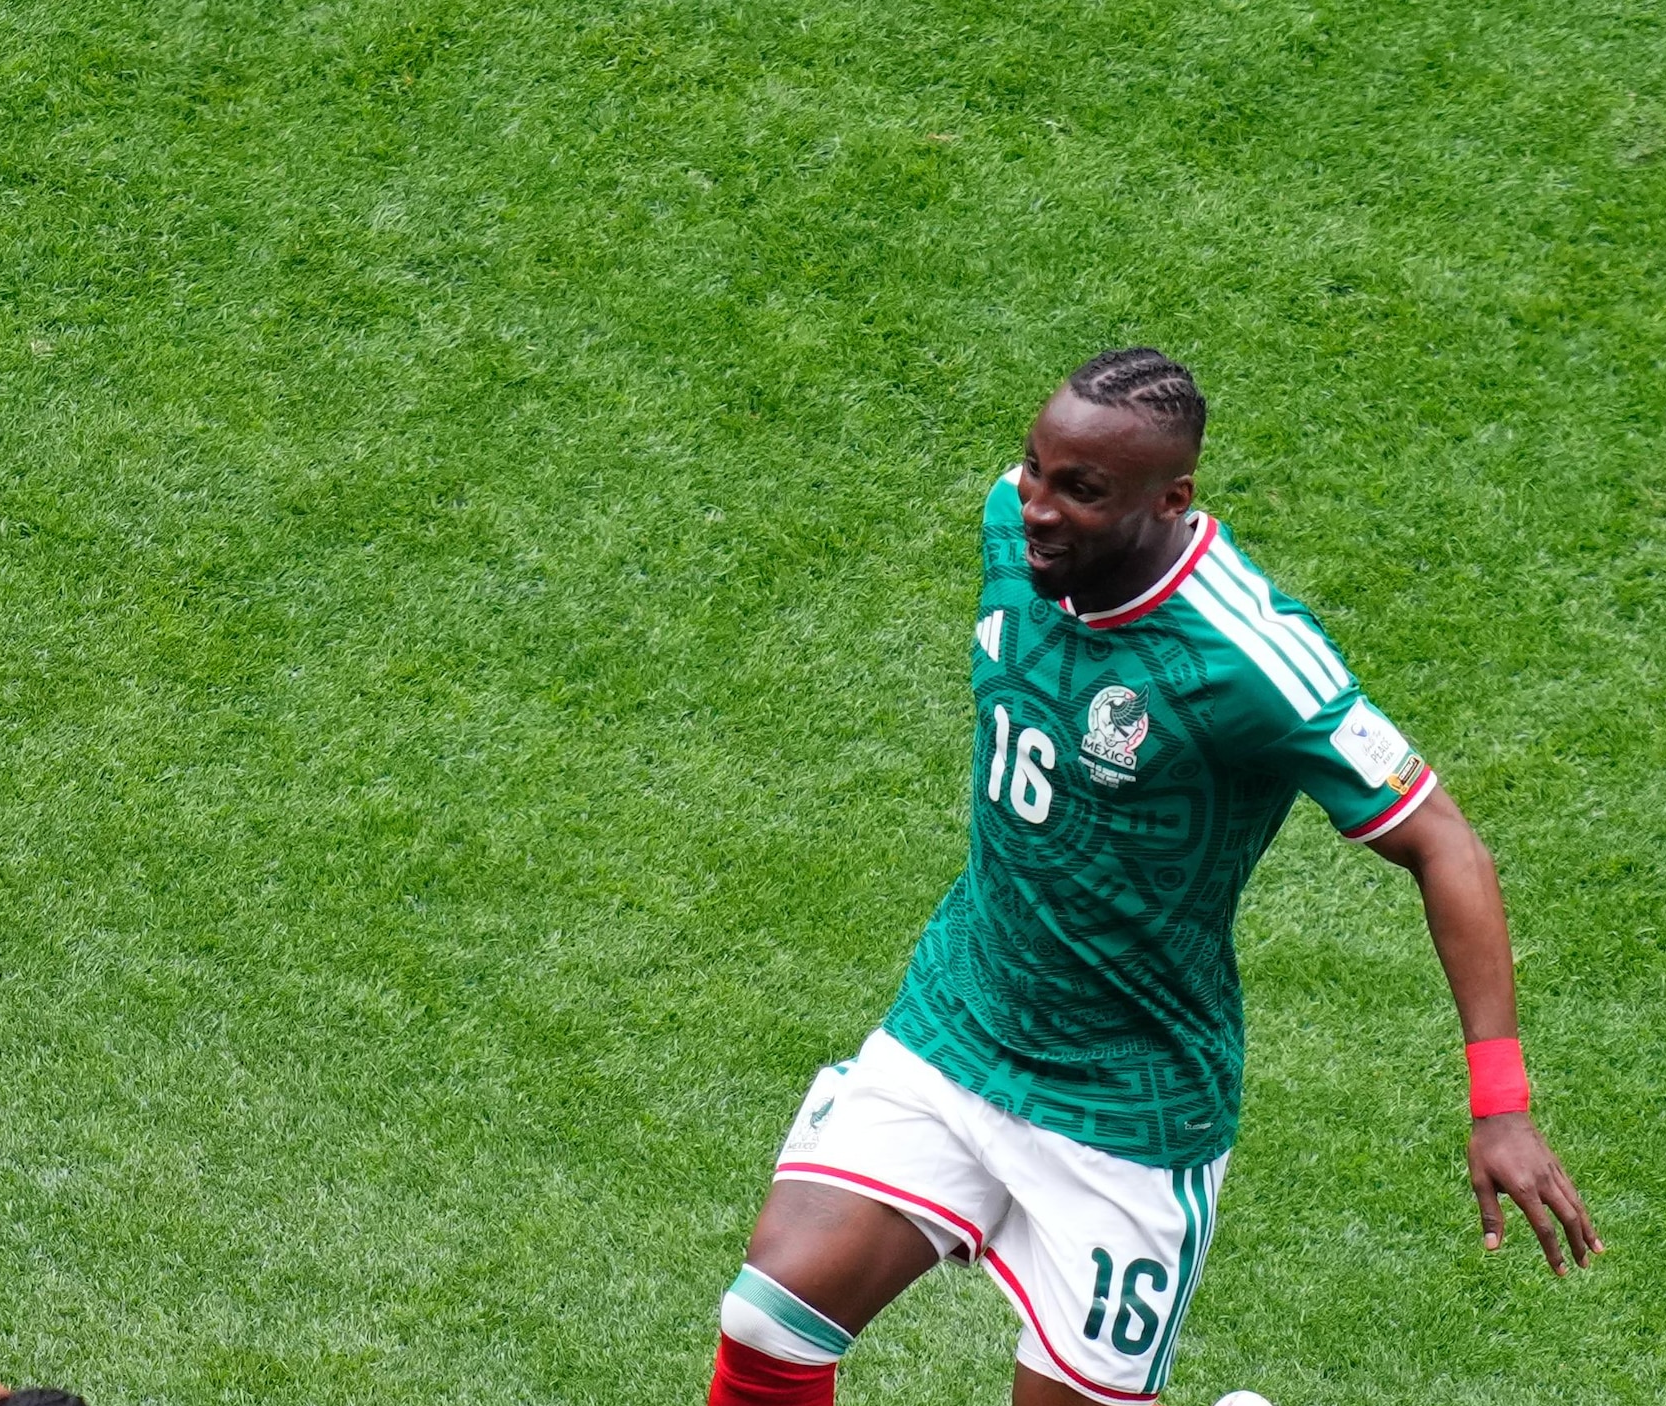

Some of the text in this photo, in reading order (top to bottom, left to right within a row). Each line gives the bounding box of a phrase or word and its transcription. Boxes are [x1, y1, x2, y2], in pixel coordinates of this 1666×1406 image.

[988, 704, 1056, 824] 16
[1083, 738, 1134, 767] MÉXICO
[1083, 1247, 1168, 1356] 16
